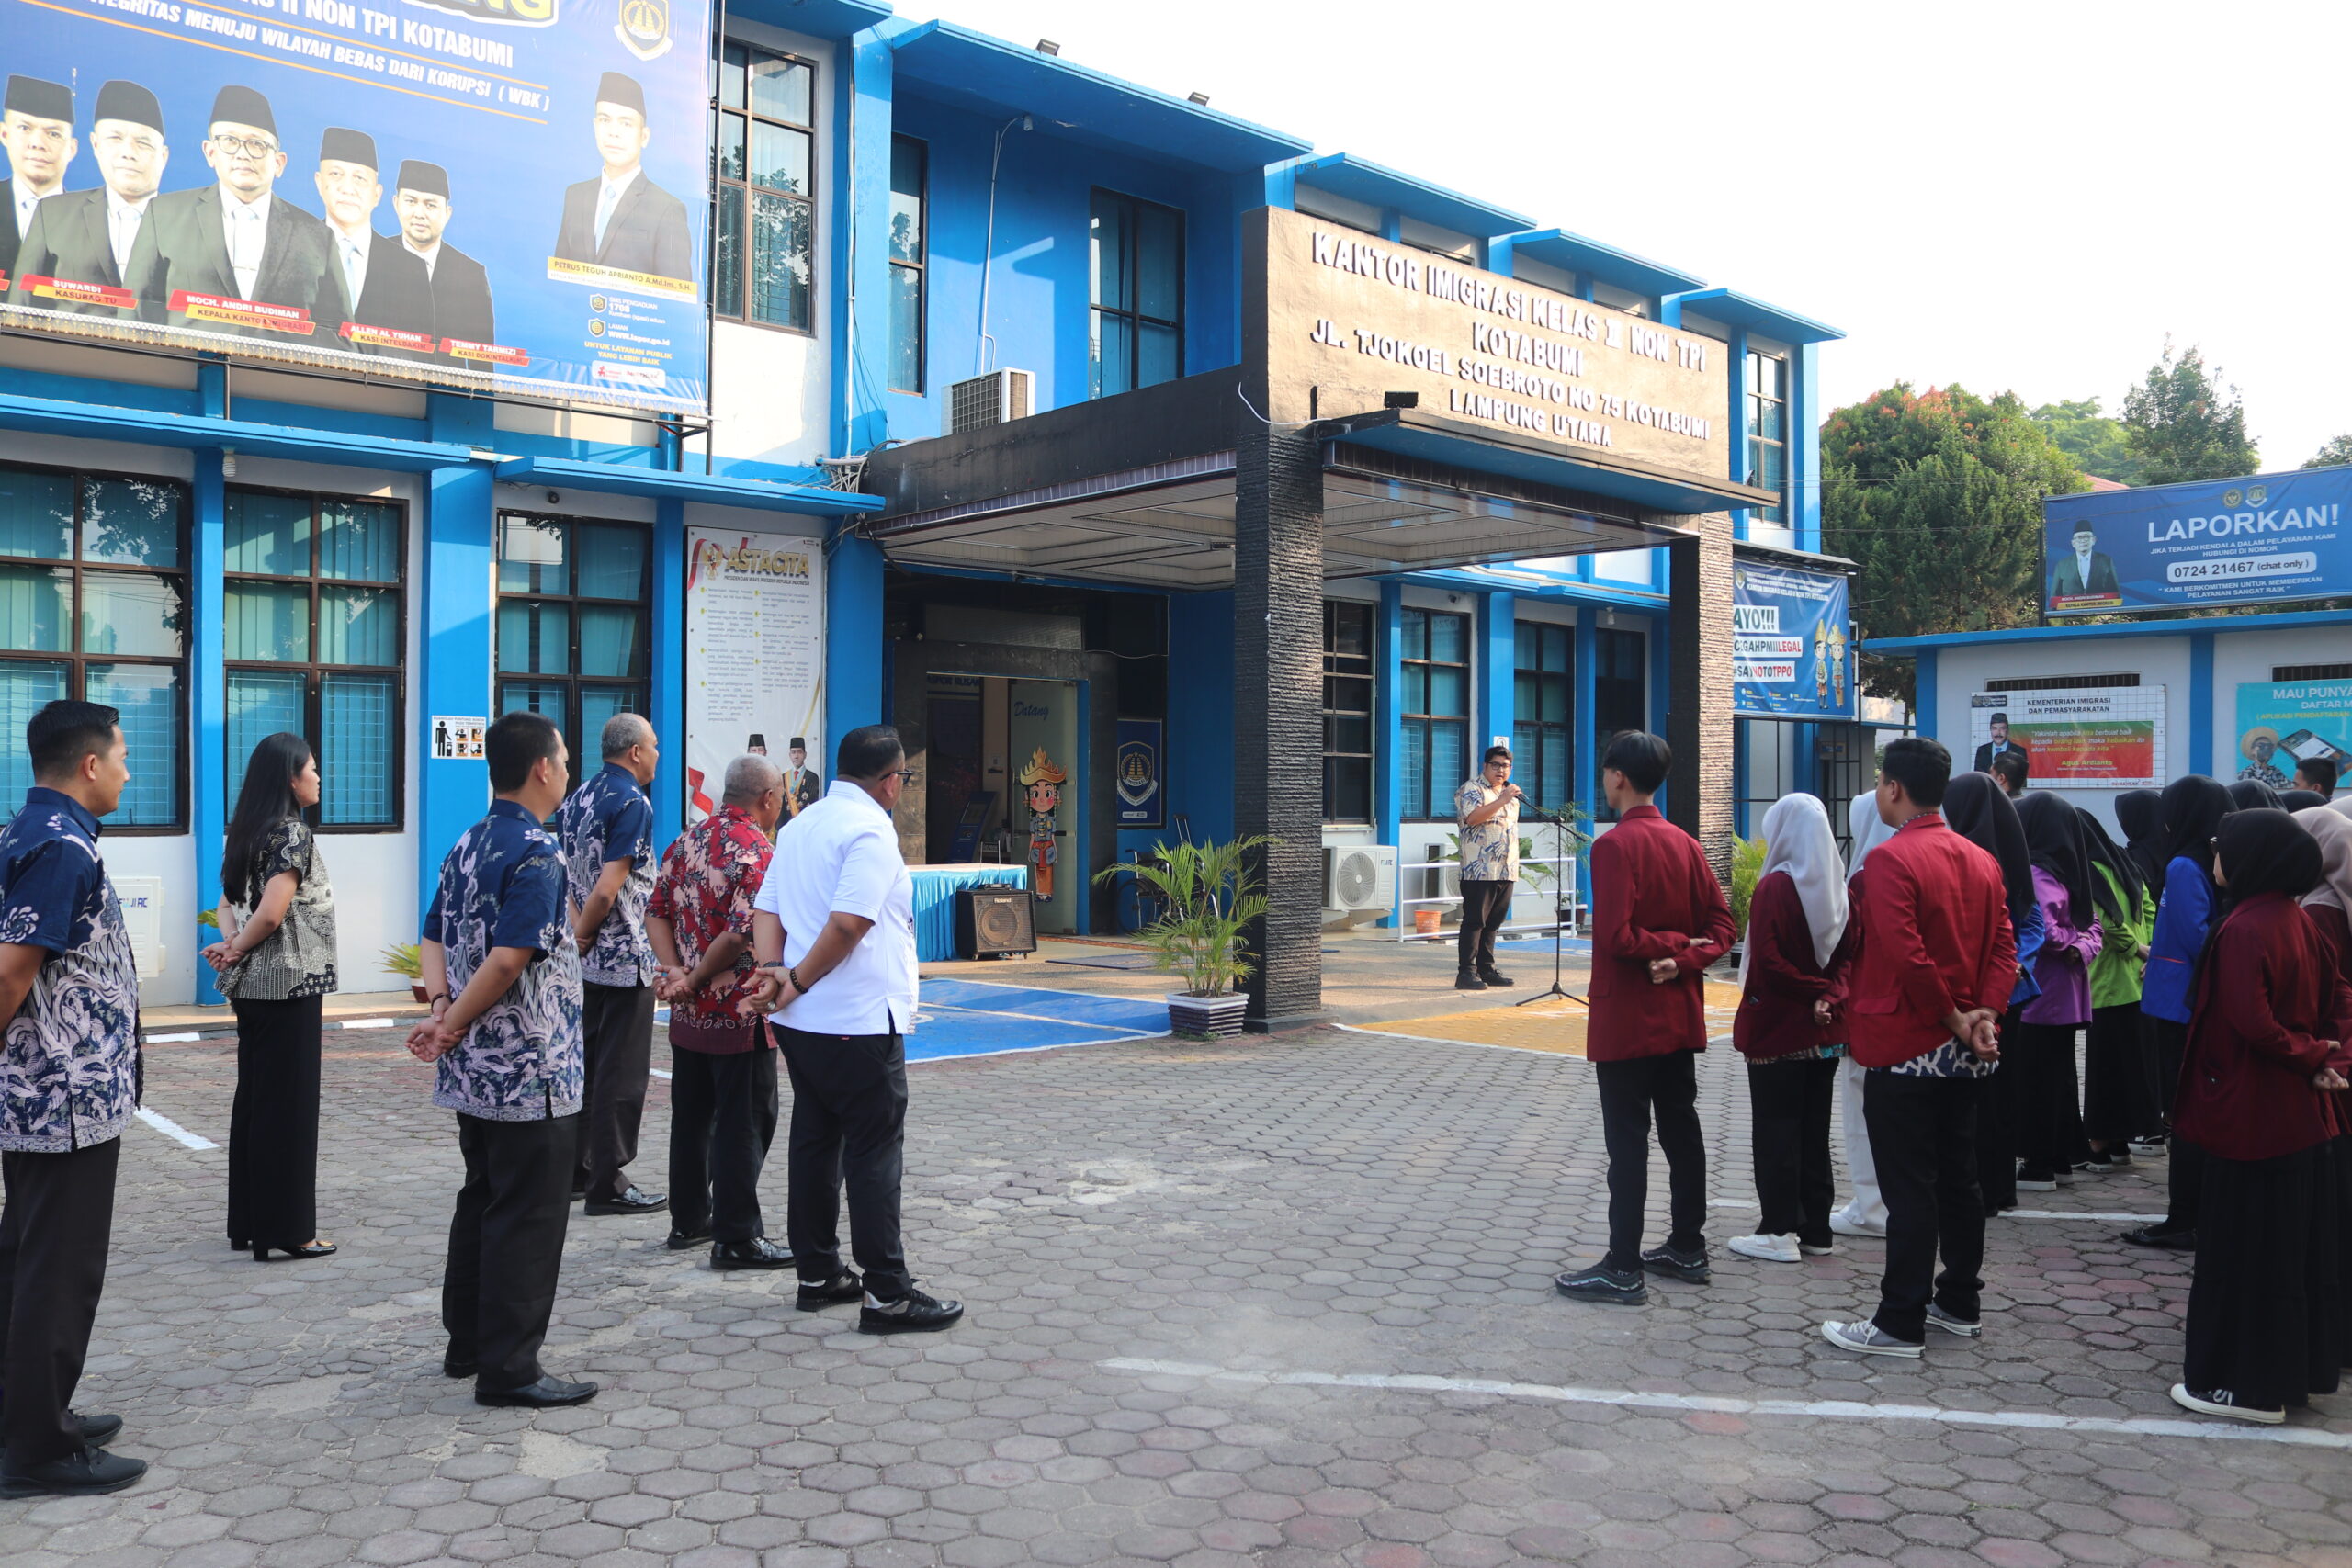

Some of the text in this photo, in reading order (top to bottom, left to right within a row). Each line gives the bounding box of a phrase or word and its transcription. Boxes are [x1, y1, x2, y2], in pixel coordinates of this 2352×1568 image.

[305, 0, 356, 29] NON
[362, 8, 397, 39] TPI
[403, 19, 514, 68] KOTABUMI
[184, 9, 258, 41] MENUJU
[262, 28, 331, 59] WILAYAH
[334, 45, 386, 72] BEBAS
[389, 59, 424, 82] DARI
[427, 68, 492, 97] KORUPSI
[554, 260, 581, 272] PETRUS
[582, 265, 606, 276] TEGUH
[608, 270, 644, 283] APRIANTO
[52, 279, 102, 294] SUWARDI
[55, 289, 118, 305] KASUBAG TU
[623, 299, 658, 310] PENGADUAN
[1313, 232, 1706, 371] KANTOR IMIGRASI KELAS II NON TPI
[187, 295, 300, 319] MOCH. ANDRI BUDIMAN
[198, 309, 231, 320] KEPALA
[609, 302, 630, 313] 1708
[350, 325, 378, 336] ALLEN
[391, 332, 422, 343] YUHAN
[360, 333, 379, 344] KASI
[450, 339, 516, 355] TEMMY TARMIZI
[458, 349, 474, 358] KASI
[584, 341, 673, 360] UNTUK LAYANAN PUBLIK
[1473, 322, 1583, 377] KOTABUMI
[598, 351, 660, 366] YANG LEBIH BAIK
[1310, 319, 1710, 440] JL. TJOKOEL SOEBROTO NO 75 KOTABUMI
[1450, 389, 1611, 446] LAMPUNG UTARA
[2148, 504, 2338, 543] LAPORKAN!
[2150, 547, 2166, 555] JIKA
[2168, 544, 2198, 554] TERJADI
[2200, 541, 2235, 551] KENDALA
[2237, 539, 2265, 547] DALAM
[2267, 535, 2313, 545] PELAYANAN
[2203, 548, 2237, 558] HUBUNGI
[2248, 546, 2278, 554] NOMOR
[2174, 565, 2207, 578] 0724
[2212, 561, 2254, 575] 21467
[2257, 559, 2280, 571] (chat
[2184, 582, 2238, 592] BERKOMITMEN
[2241, 580, 2267, 589] UNTUK
[2268, 577, 2323, 587] MEMBERIKAN
[2188, 590, 2231, 599] PELAYANAN
[2233, 588, 2264, 596] SANGAT
[1734, 608, 1775, 631] AYO!!!
[2027, 698, 2076, 706] KEMENTERIAN
[2273, 688, 2305, 699] MAU
[1014, 701, 1049, 721] Datang
[2301, 701, 2341, 709] DAFTAR
